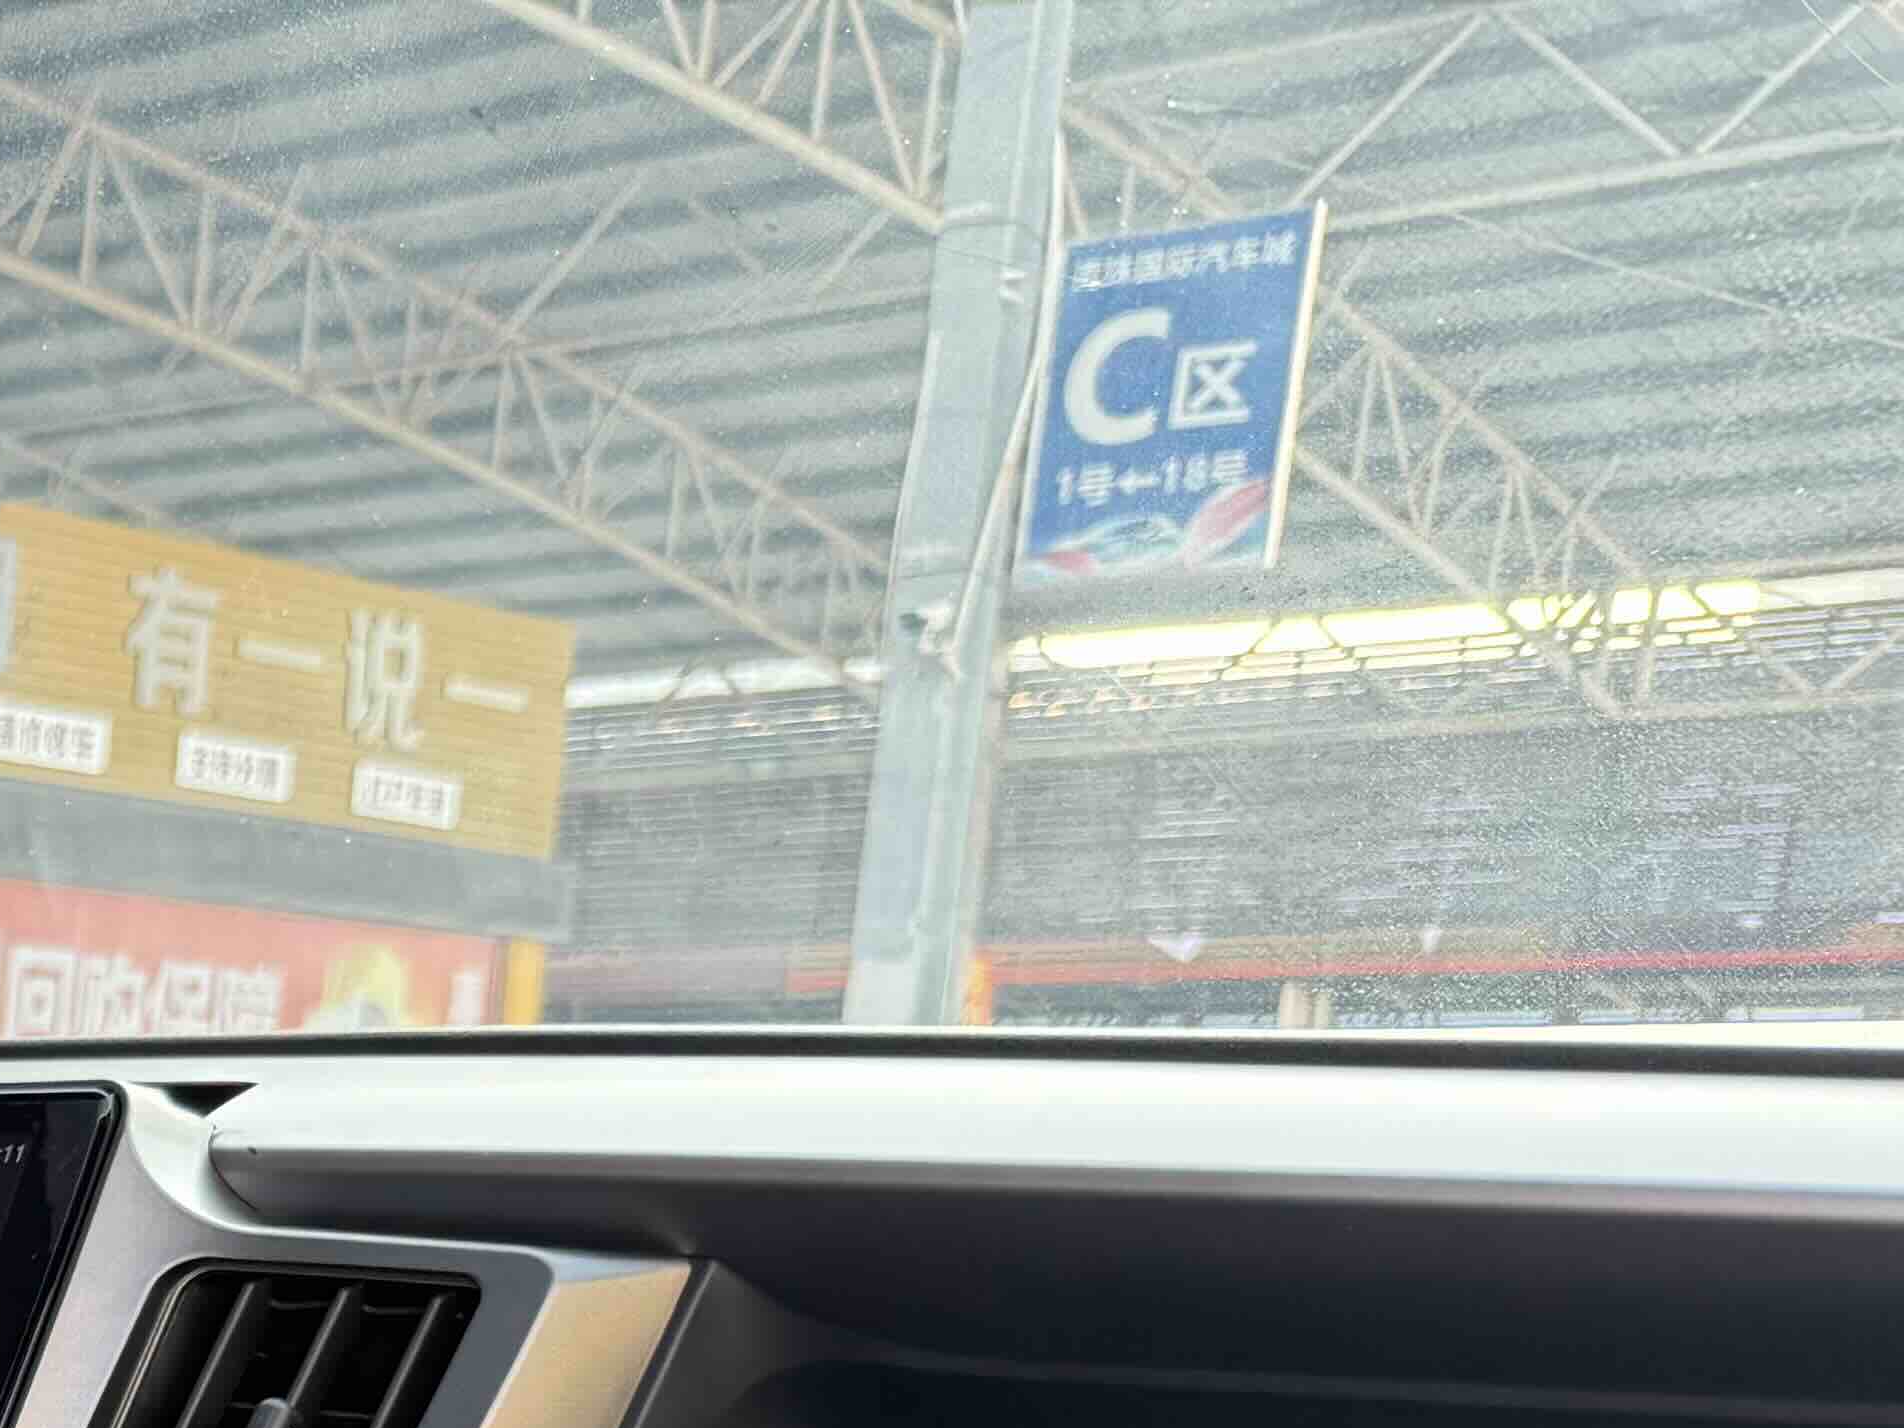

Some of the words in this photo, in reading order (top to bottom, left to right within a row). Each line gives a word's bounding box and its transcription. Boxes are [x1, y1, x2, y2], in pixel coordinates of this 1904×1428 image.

[1064, 305, 1259, 446] C区
[125, 565, 530, 750] 有一说一
